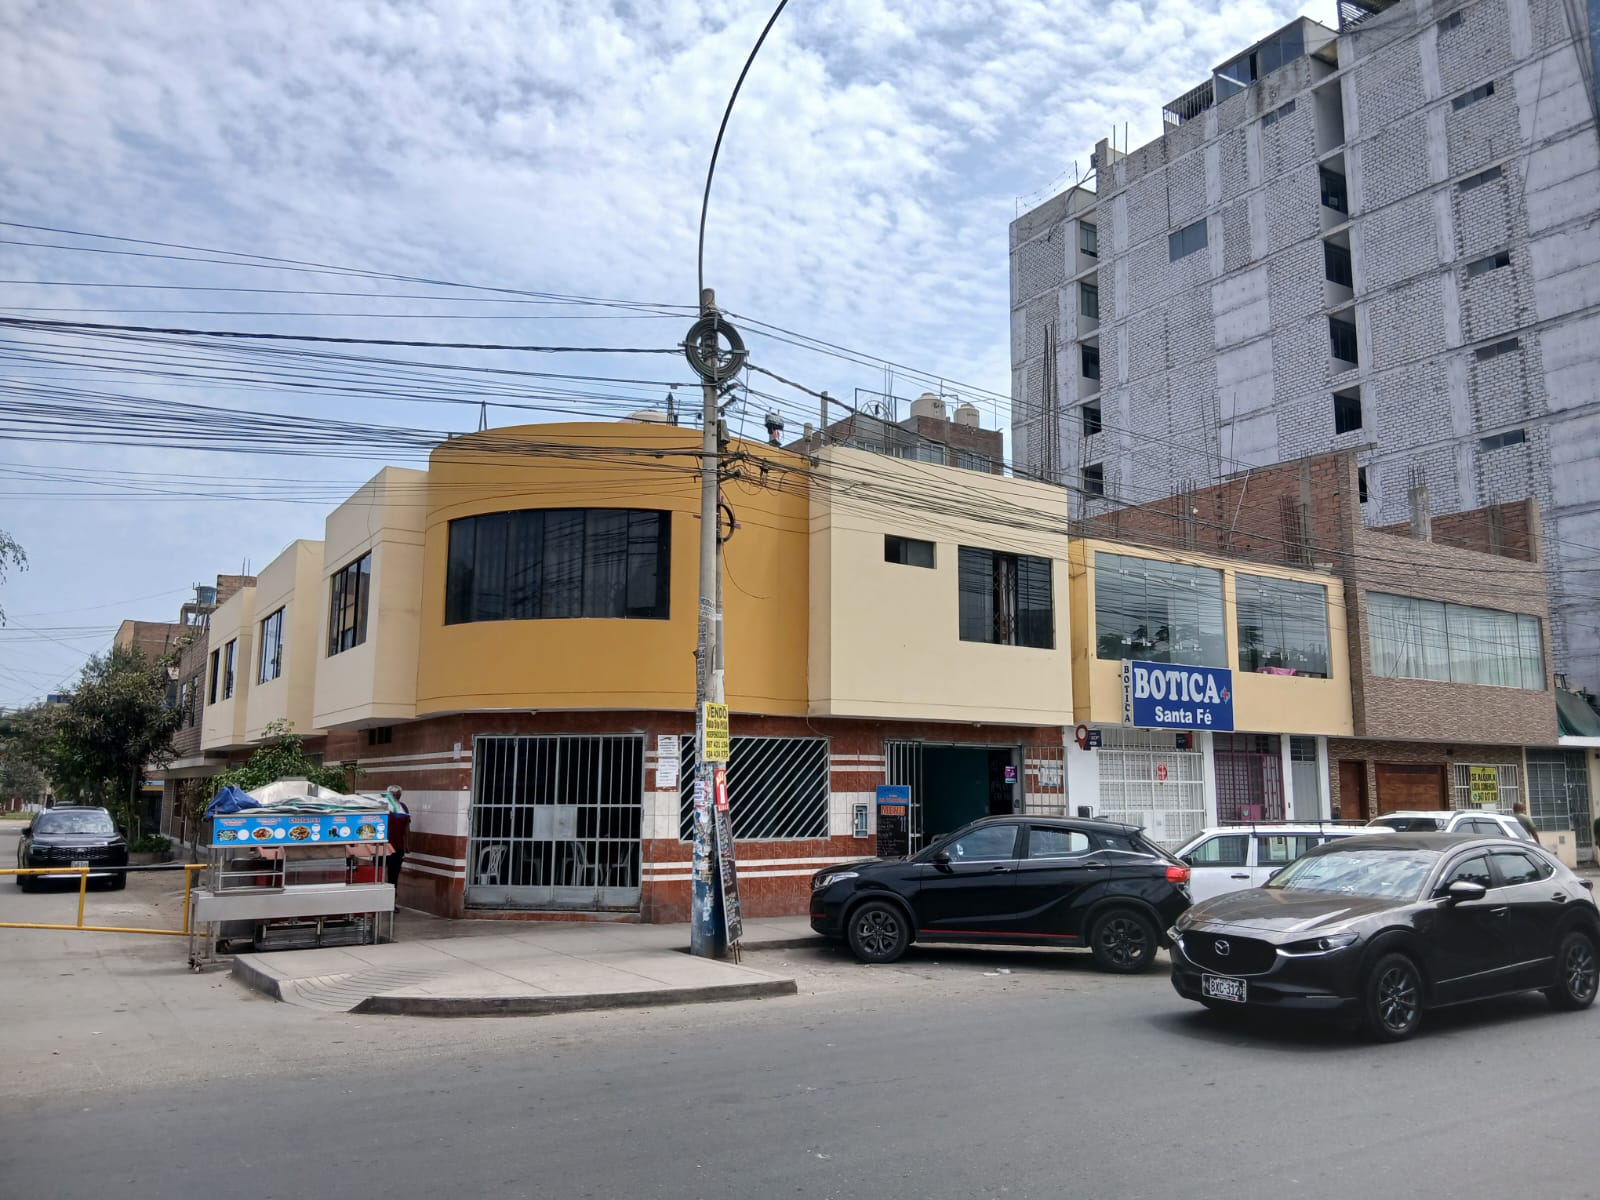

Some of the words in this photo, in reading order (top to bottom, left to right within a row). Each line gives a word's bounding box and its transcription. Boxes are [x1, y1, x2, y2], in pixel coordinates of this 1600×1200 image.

[1133, 667, 1221, 704] BOTICA
[706, 706, 728, 719] VENDO
[1155, 706, 1193, 724] Santa
[1196, 708, 1212, 725] Fé
